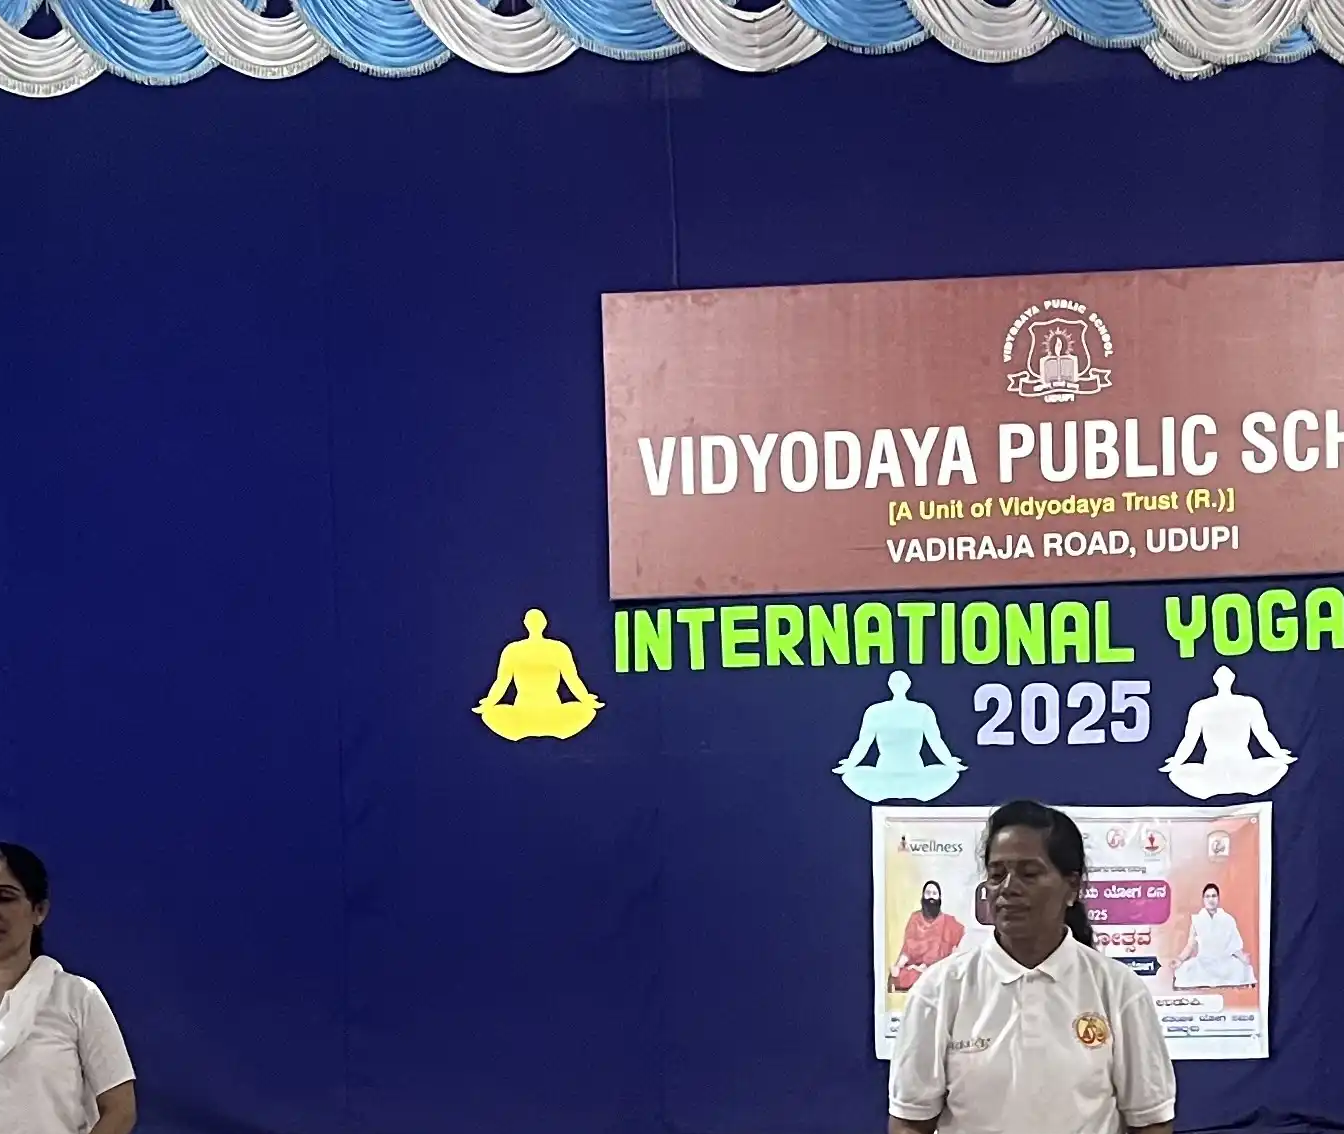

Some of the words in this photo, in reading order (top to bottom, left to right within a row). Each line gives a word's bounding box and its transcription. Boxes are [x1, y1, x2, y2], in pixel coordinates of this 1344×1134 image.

[1043, 298, 1087, 314] PUBLIC
[1088, 312, 1114, 358] SCHOOL
[638, 425, 978, 496] VIDYODAYA
[998, 413, 1218, 483] PUBLIC
[888, 501, 913, 526] [A
[919, 499, 964, 520] Unit
[971, 497, 993, 517] of
[998, 493, 1116, 521] Vidyodaya
[1122, 491, 1179, 511] Trust
[1185, 488, 1236, 514] (R.)]
[886, 534, 1035, 563] VADIRAJA
[1043, 530, 1137, 559] ROAD,
[1146, 526, 1240, 553] UDUPI
[613, 600, 1136, 673] INTERNATIONAL
[973, 679, 1151, 746] 2025
[909, 839, 963, 853] wellness
[1087, 908, 1108, 921] 025
